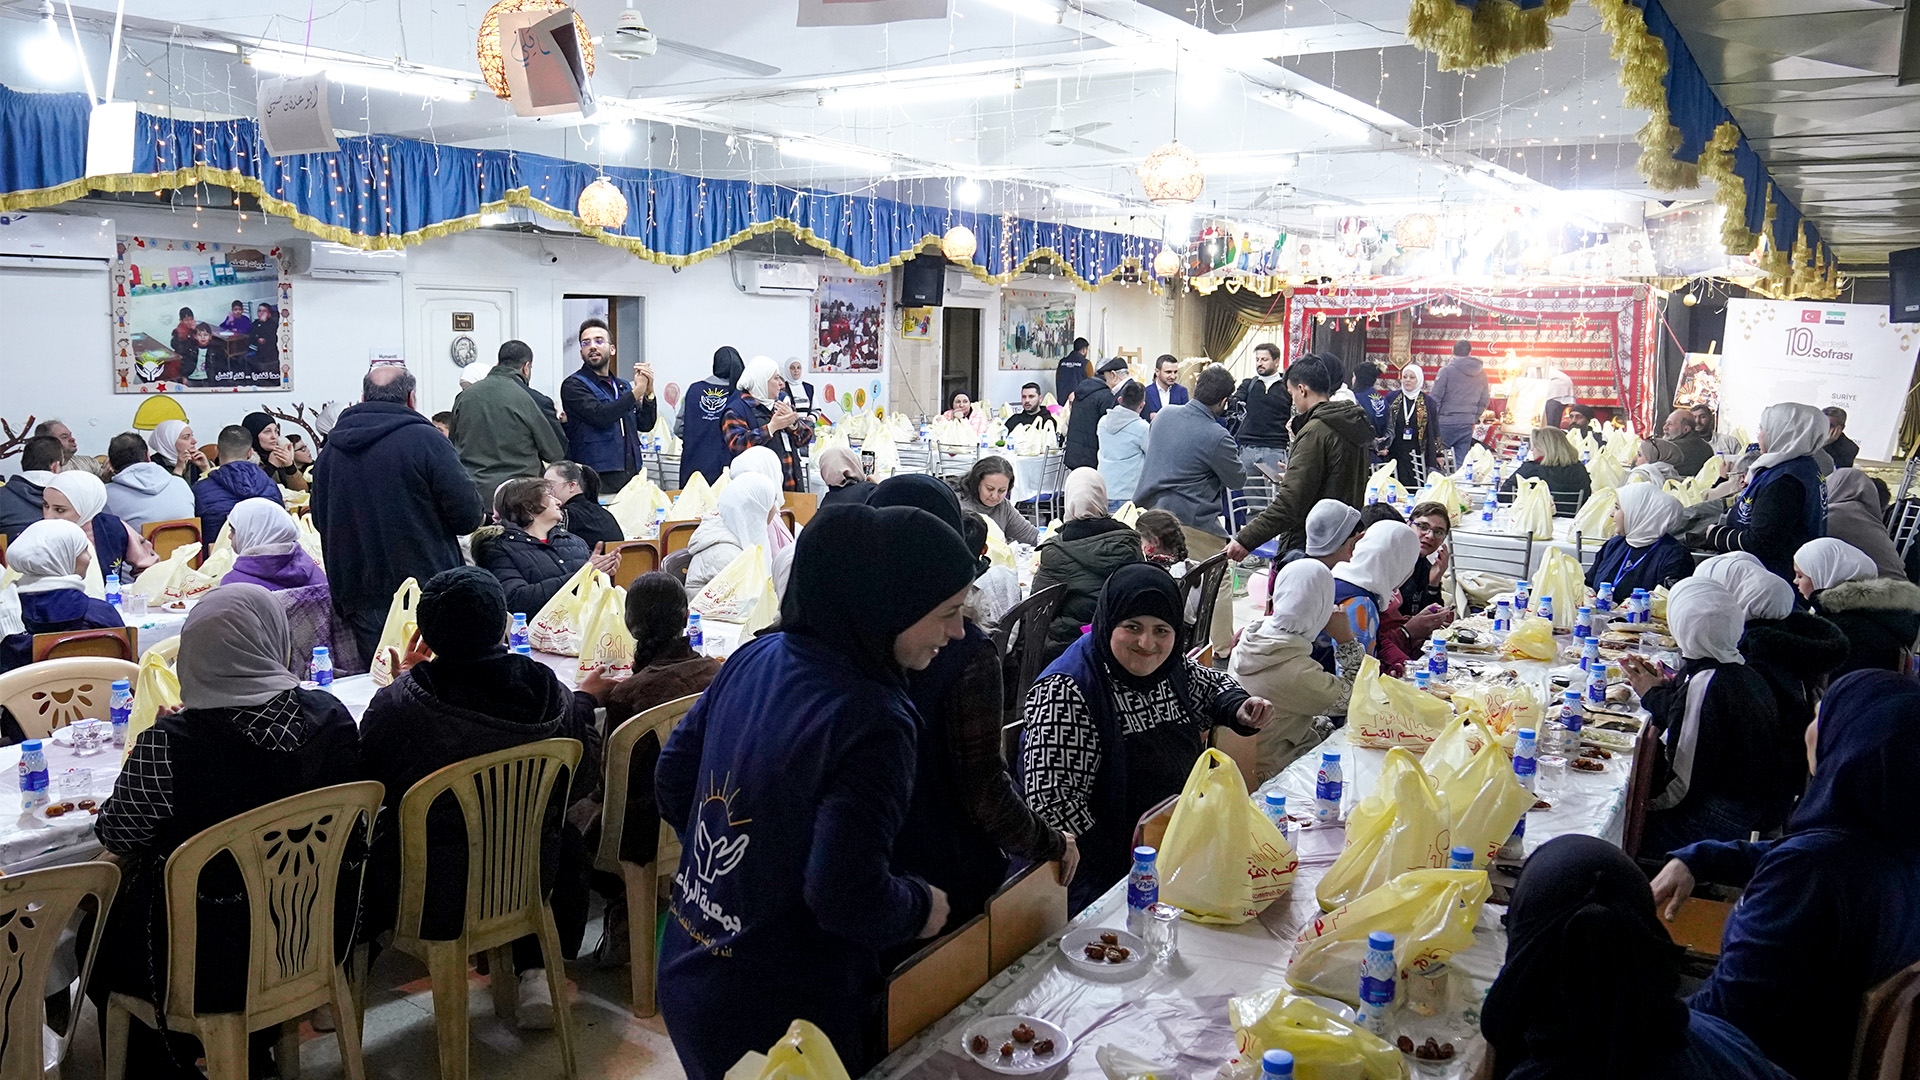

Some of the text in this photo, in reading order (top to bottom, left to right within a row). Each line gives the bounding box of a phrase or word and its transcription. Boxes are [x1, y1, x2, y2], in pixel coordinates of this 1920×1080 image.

[1814, 338, 1849, 350] Kardeşlik
[1812, 347, 1854, 361] Sofrası
[1831, 392, 1858, 402] SURİYE
[699, 886, 742, 937] جمعية
